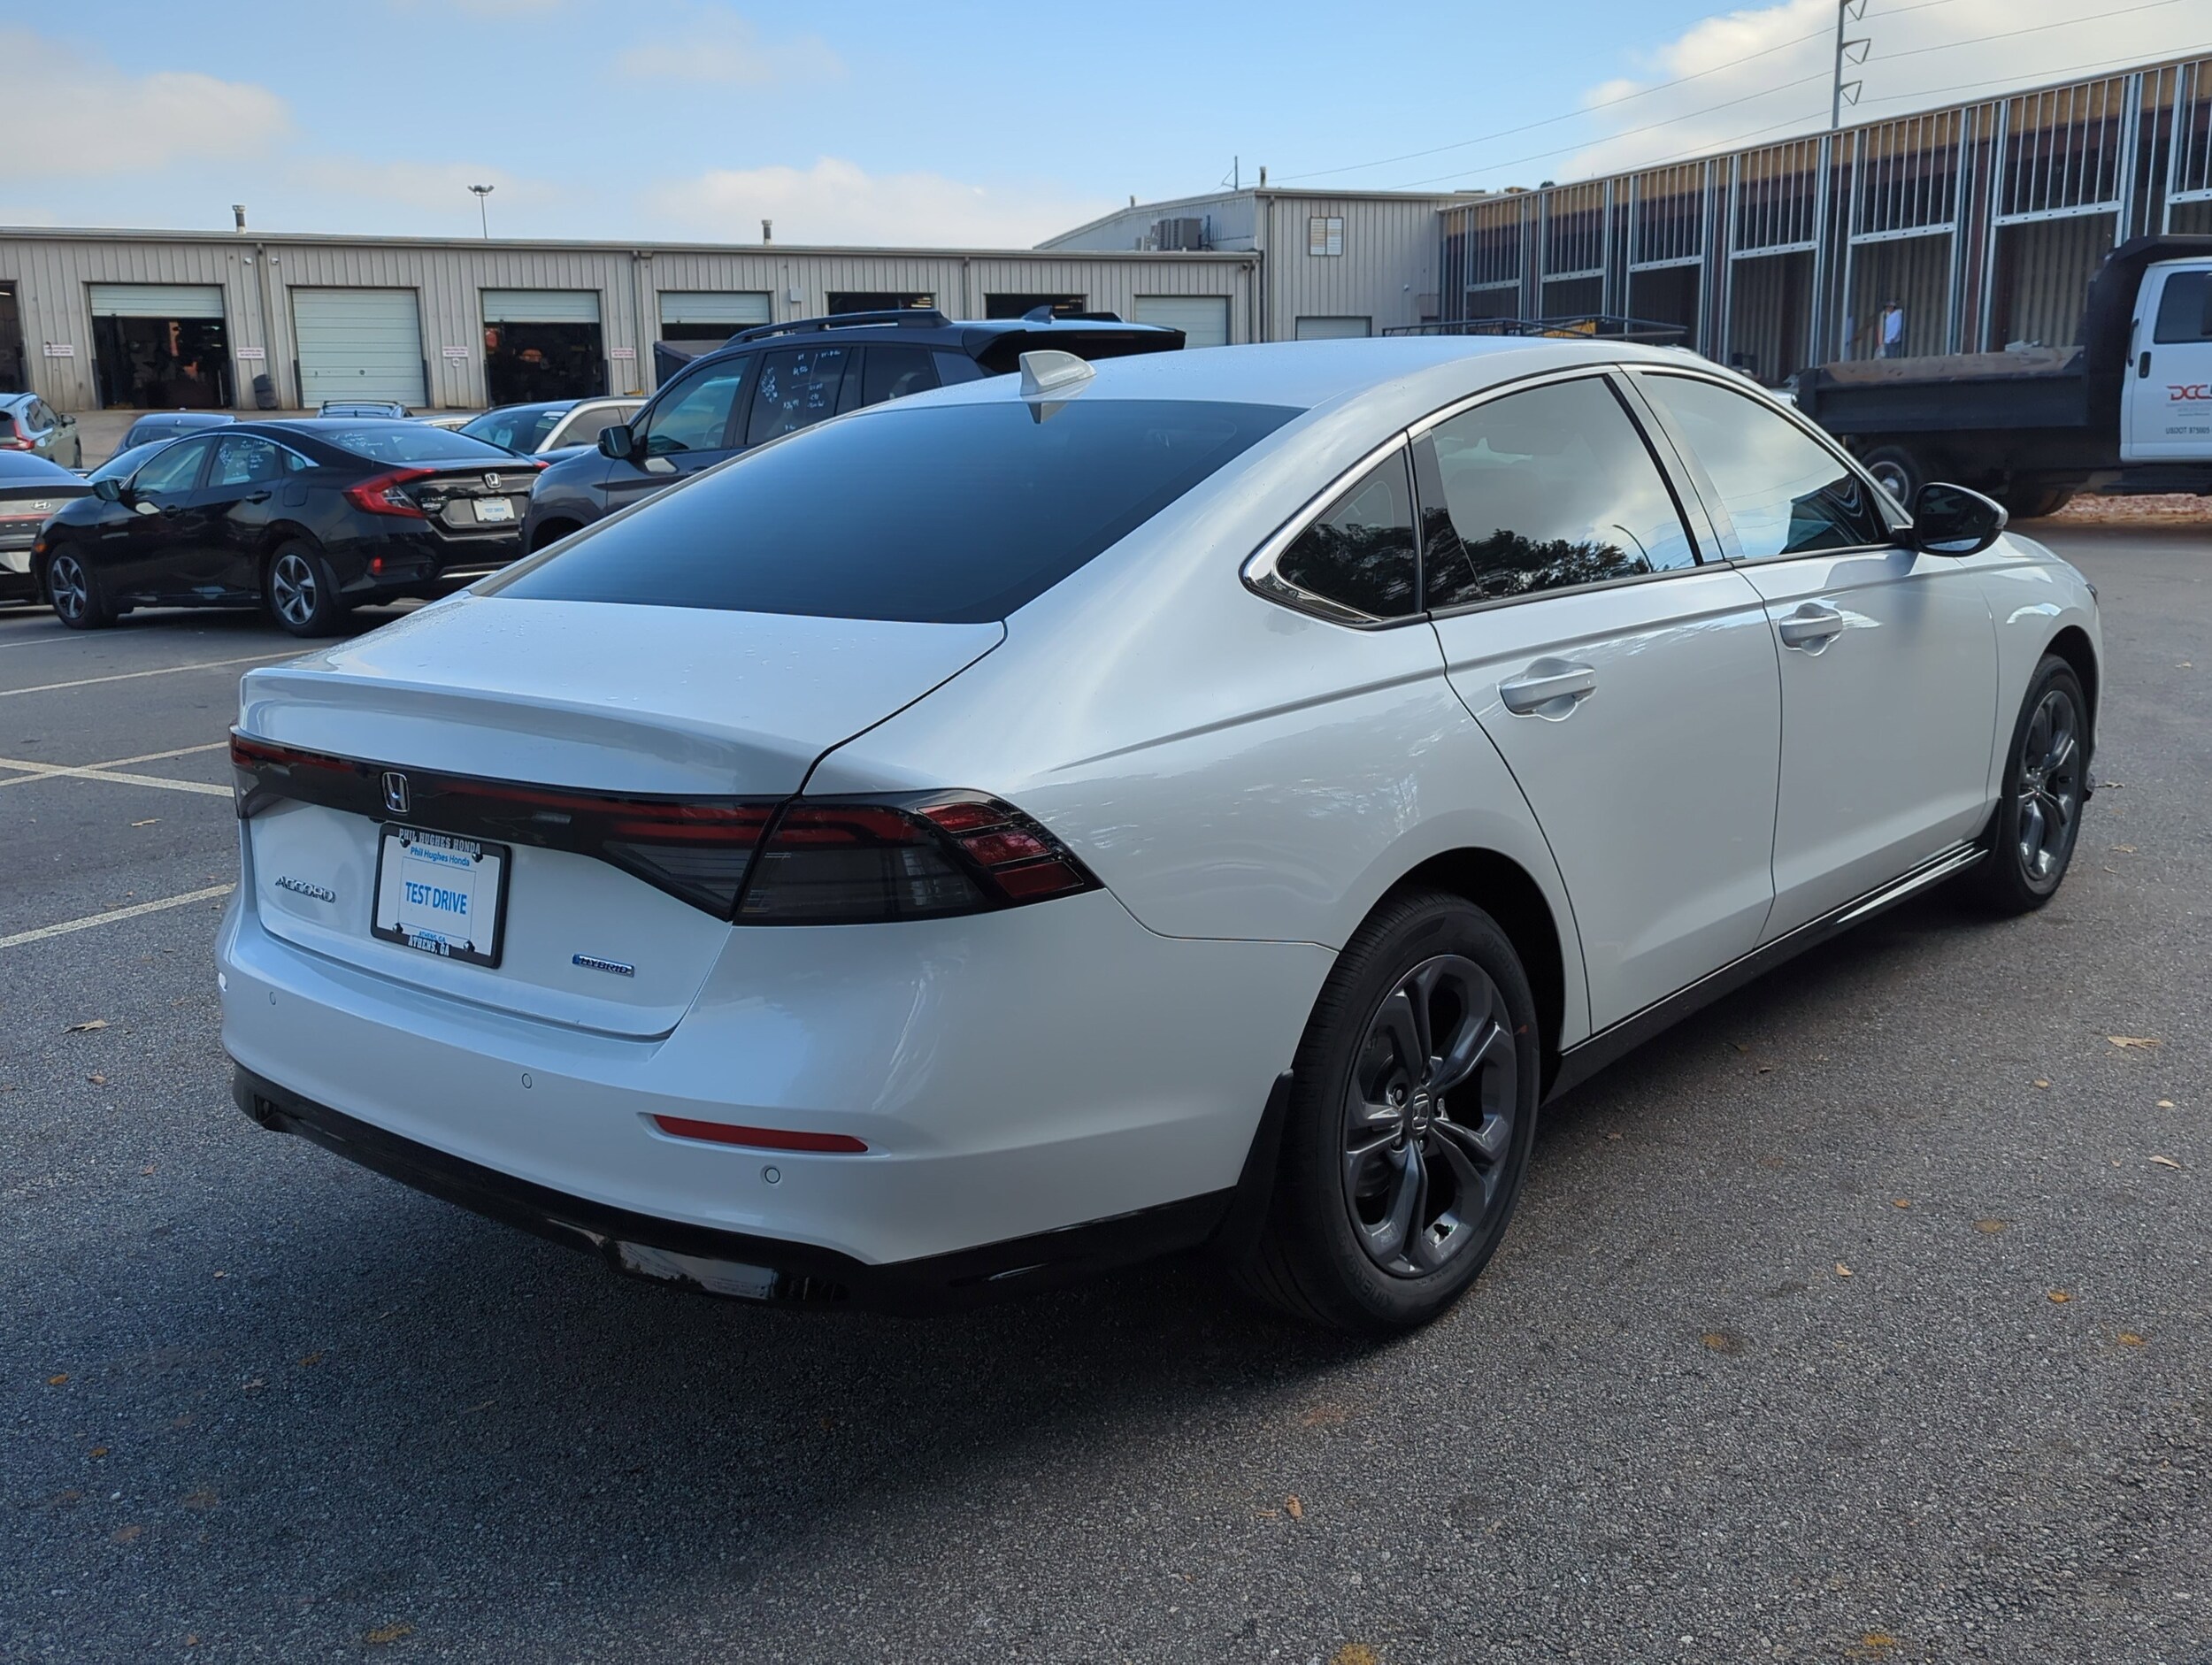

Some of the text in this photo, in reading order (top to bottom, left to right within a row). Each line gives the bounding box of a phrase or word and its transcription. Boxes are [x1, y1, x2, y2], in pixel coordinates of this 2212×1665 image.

[398, 828, 481, 855] PHIL HUGHES HONDA
[410, 846, 470, 867] Phil Hughes Honda
[274, 875, 336, 903] ACCORD
[405, 881, 467, 915] TEST DRIVE
[408, 934, 450, 956] ATHENS, GA
[580, 957, 629, 975] HYBRID
